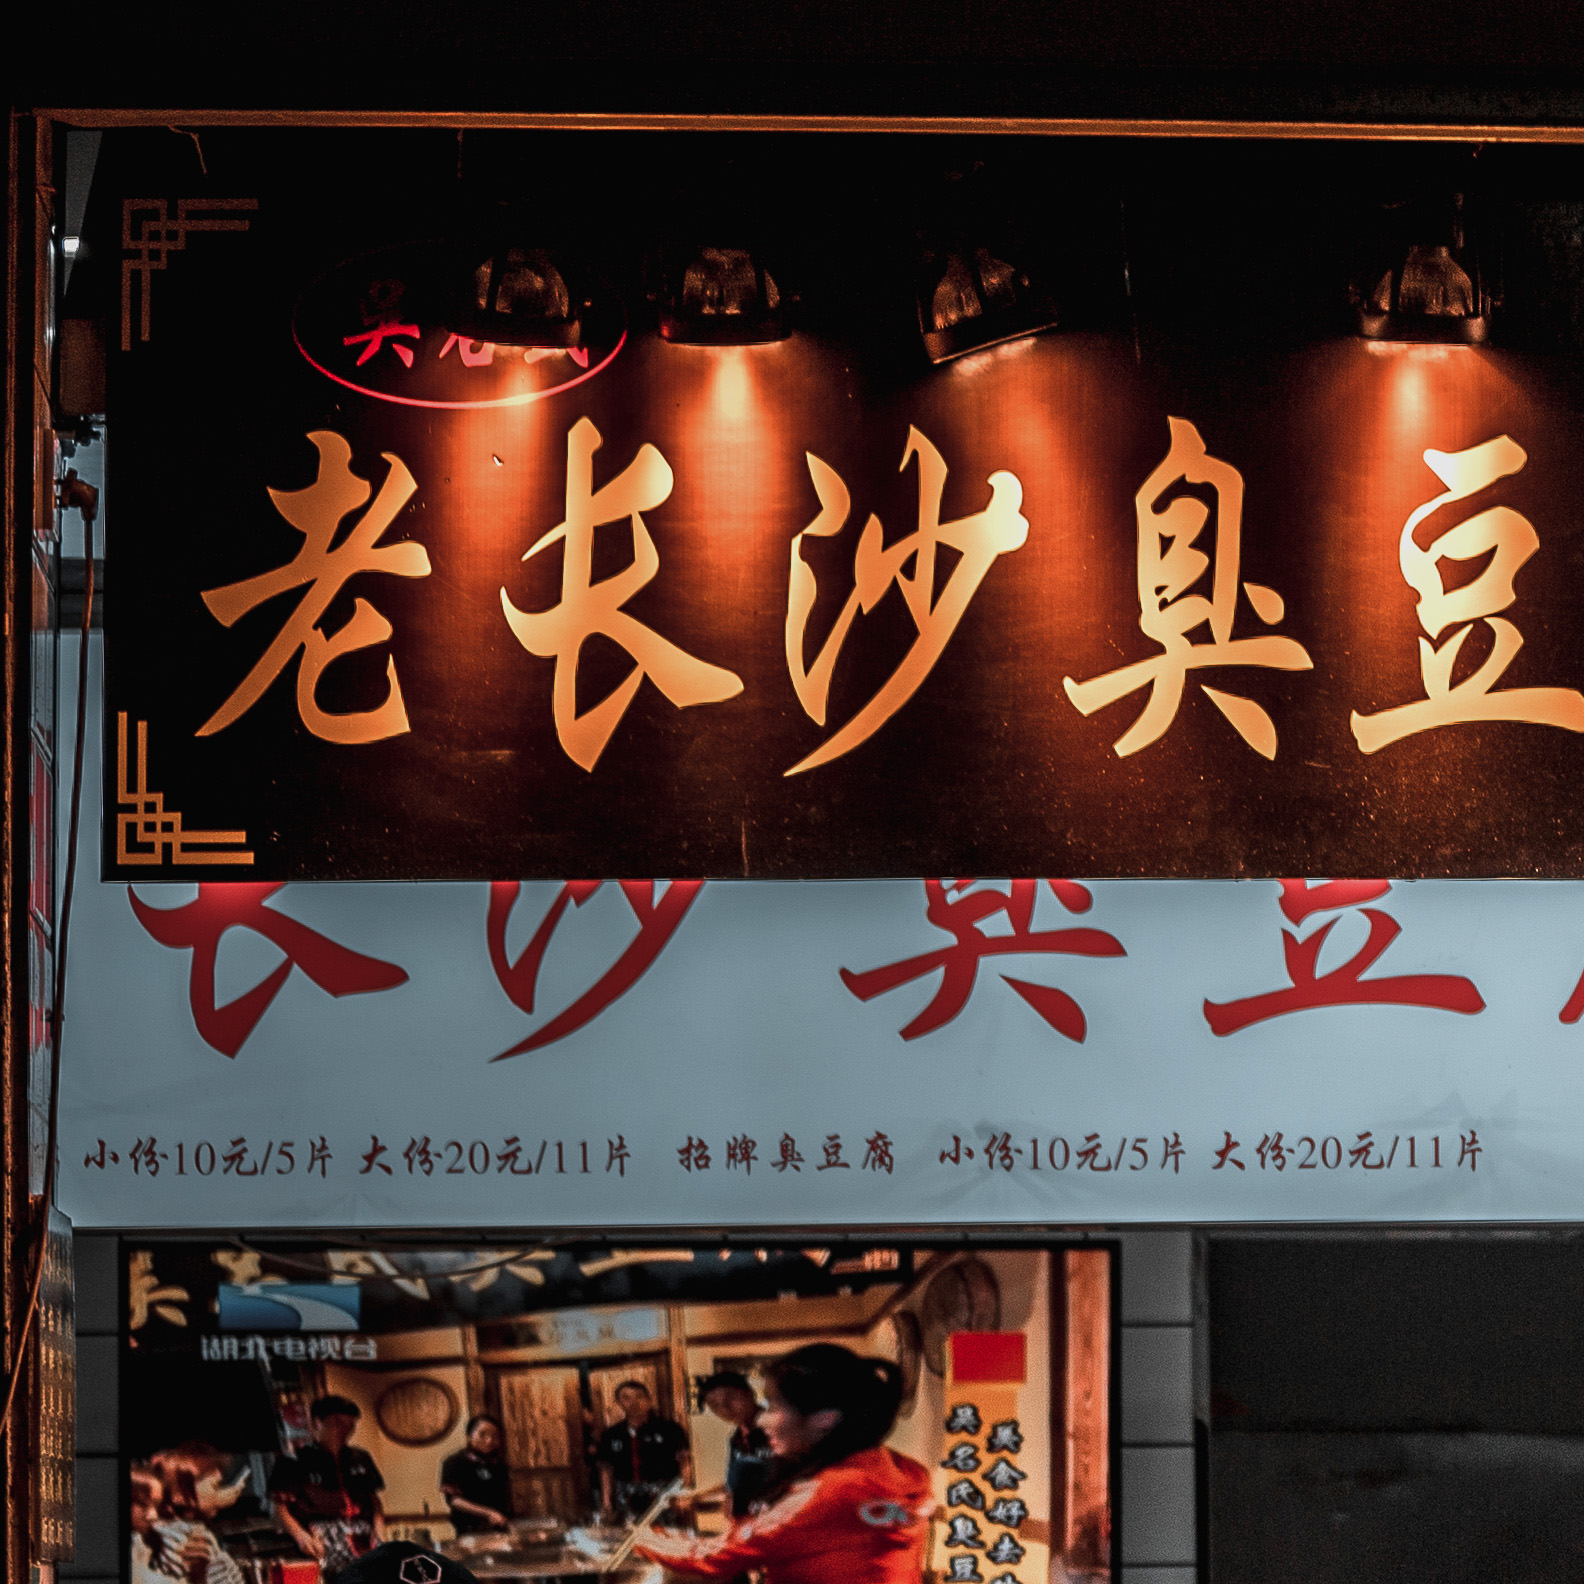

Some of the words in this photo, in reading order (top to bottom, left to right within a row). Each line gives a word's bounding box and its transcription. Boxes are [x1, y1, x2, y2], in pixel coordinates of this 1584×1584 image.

[83, 1133, 335, 1178] 小份10元/5片
[357, 1133, 632, 1178] 大份20元/11片
[677, 1133, 896, 1175] 招牌臭豆腐
[938, 1132, 1189, 1177] 小份10元/5片
[1211, 1131, 1486, 1176] 大份20元/11片
